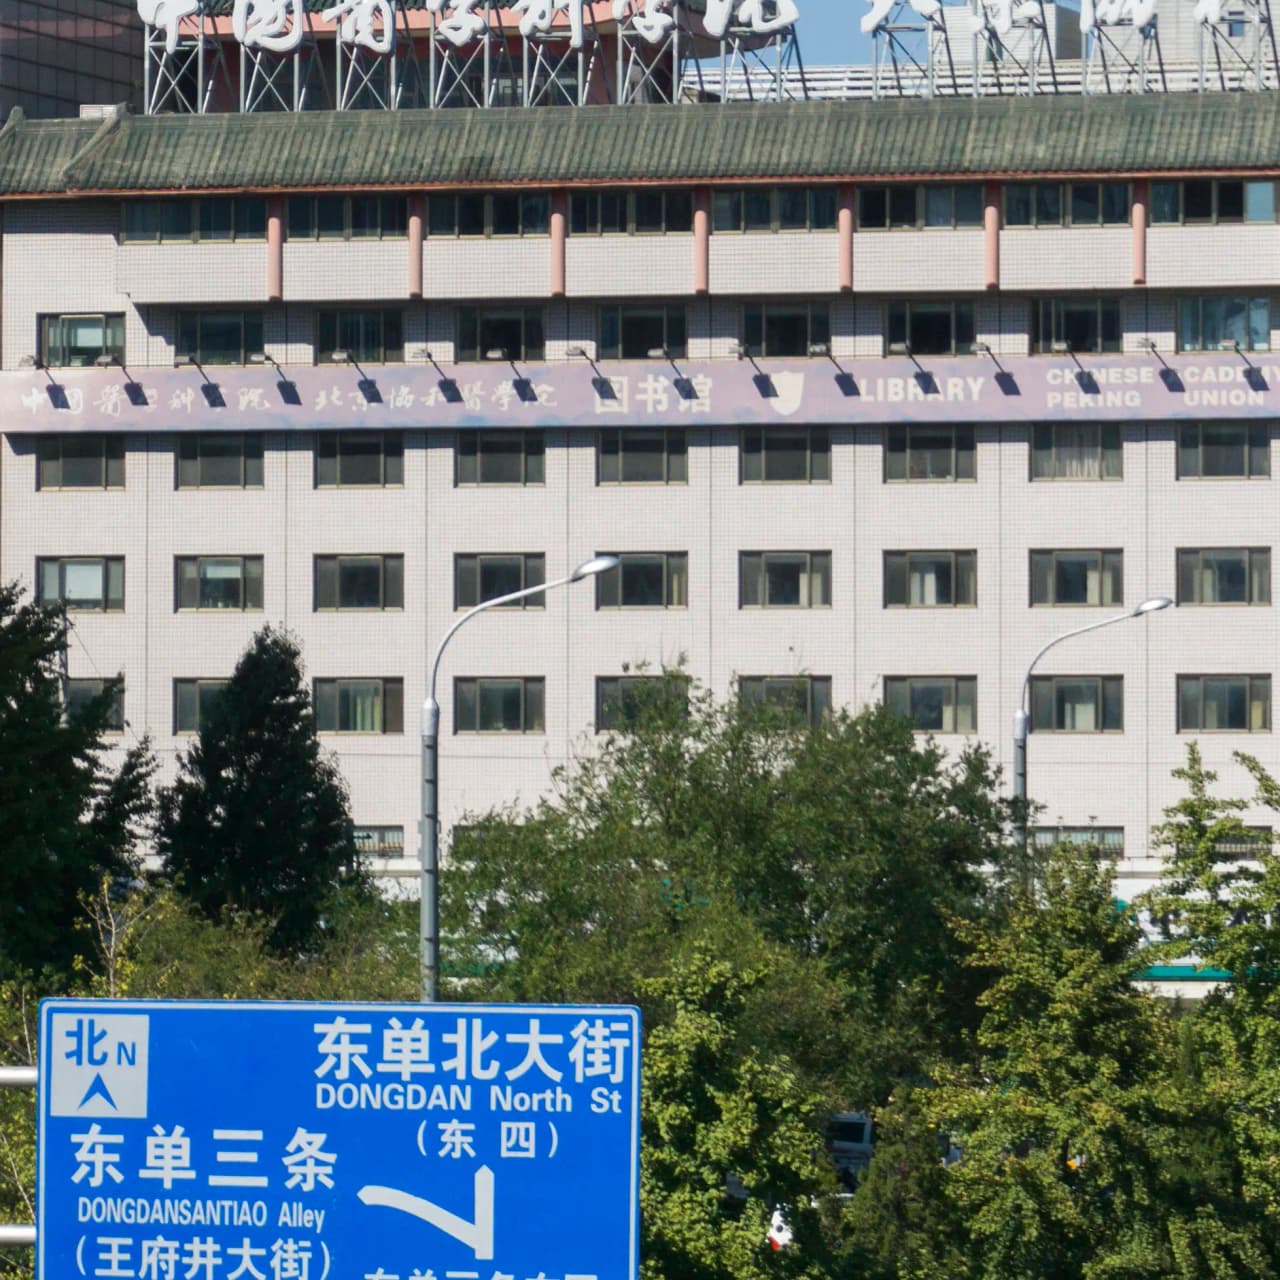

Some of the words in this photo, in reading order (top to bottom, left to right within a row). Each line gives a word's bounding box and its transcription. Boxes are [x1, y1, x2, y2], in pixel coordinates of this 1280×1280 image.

[1046, 367, 1154, 384] CHNESE
[1046, 391, 1141, 408] PEKING
[1184, 389, 1264, 407] UNION
[65, 1019, 108, 1066] 北
[117, 1042, 136, 1066] N
[314, 1016, 630, 1083] 东单北大街
[316, 1083, 471, 1111] DONGDAN
[490, 1085, 572, 1113] North
[590, 1087, 622, 1114] St
[70, 1123, 337, 1192] 东单三条
[78, 1197, 267, 1227] DONGDANSANTIAO
[278, 1202, 325, 1233] Alley
